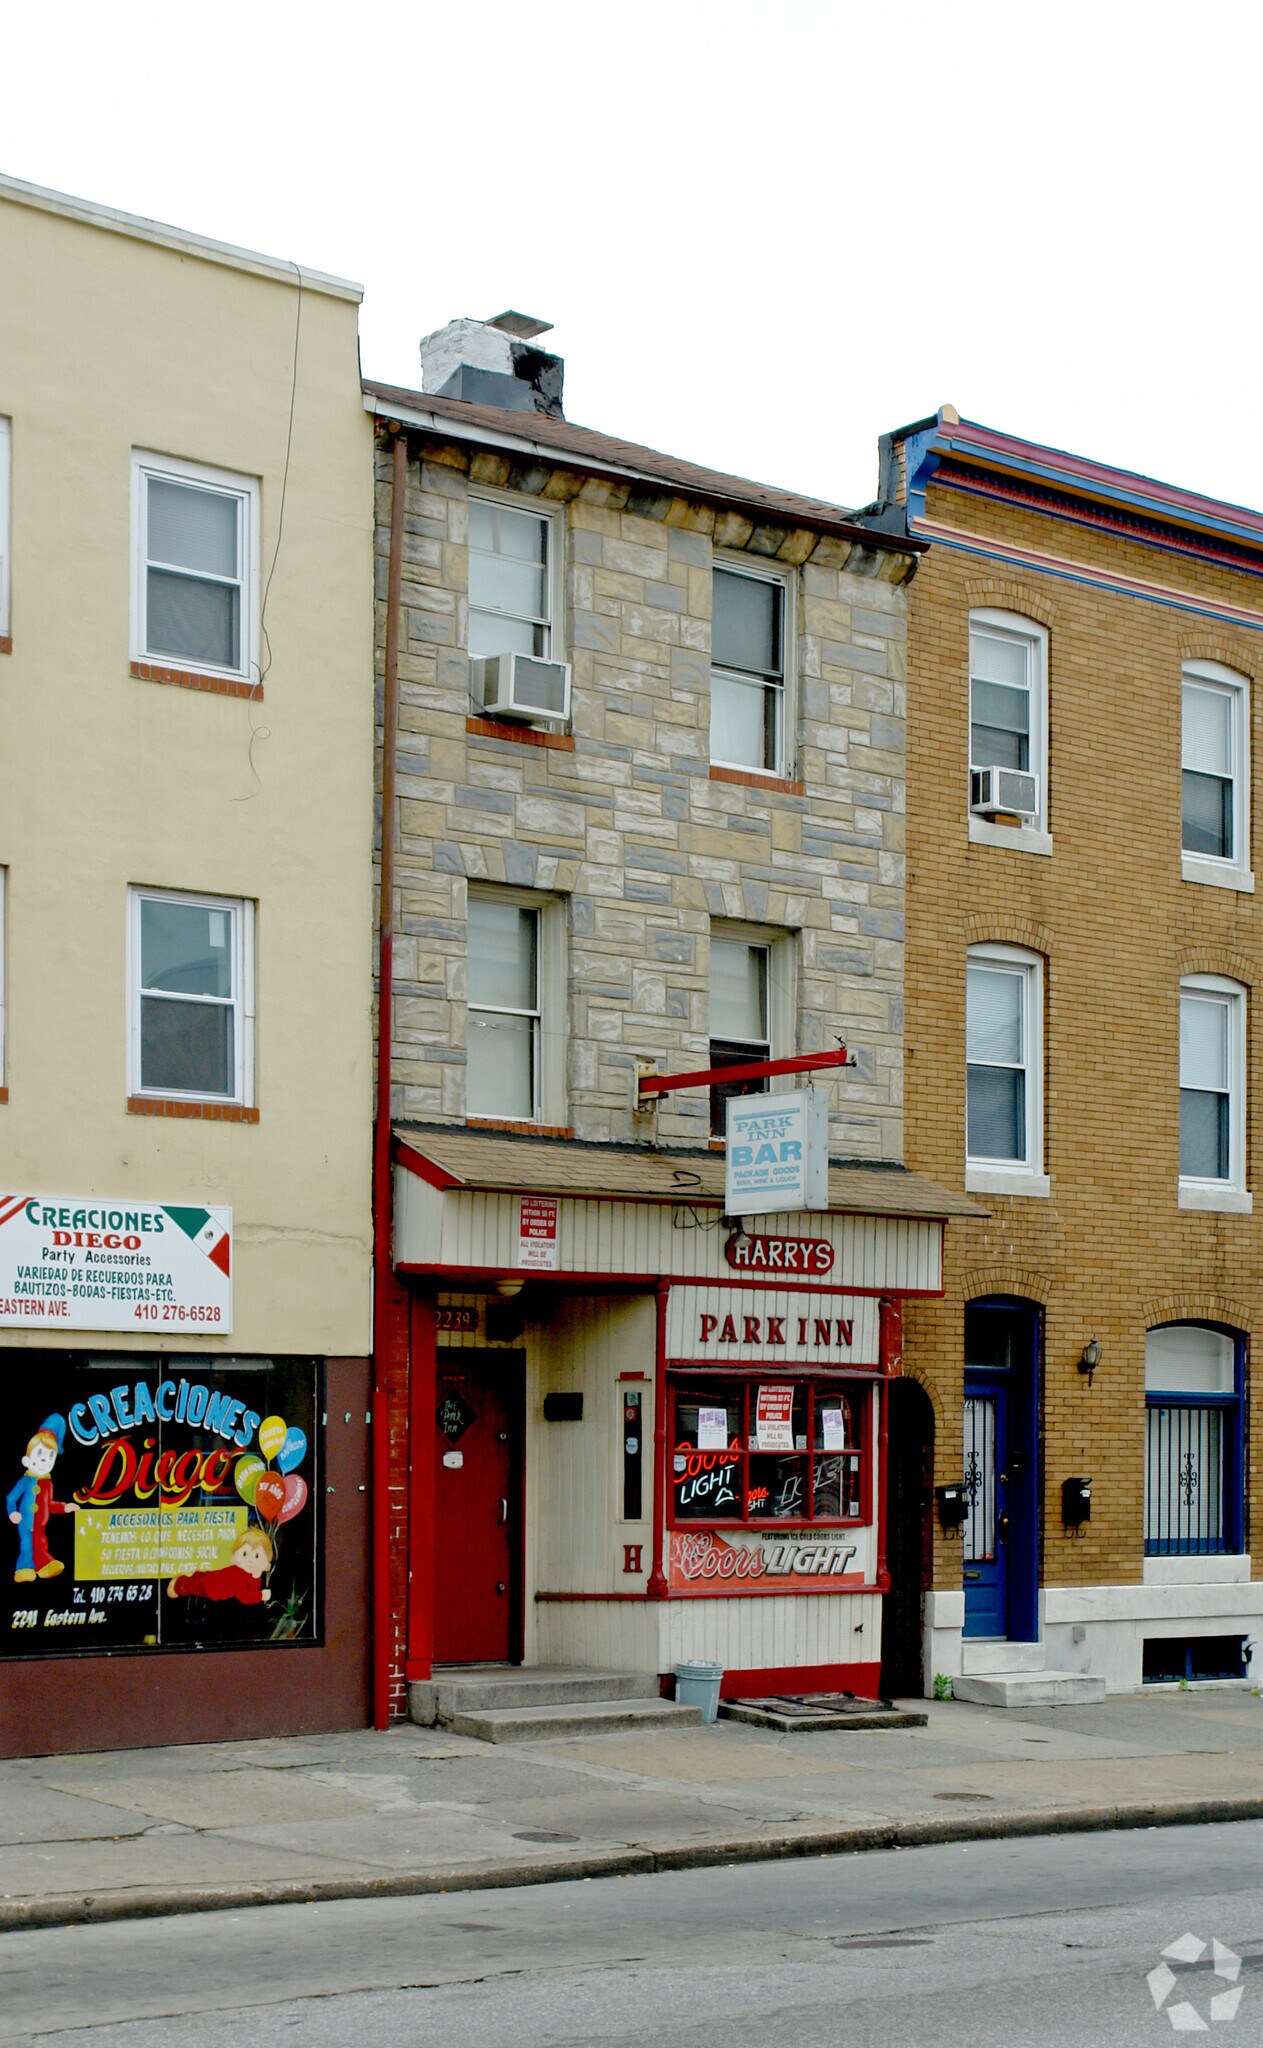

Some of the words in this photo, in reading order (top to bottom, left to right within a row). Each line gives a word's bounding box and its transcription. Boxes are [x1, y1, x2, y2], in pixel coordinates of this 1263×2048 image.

[736, 1116, 794, 1132] PARK
[747, 1128, 787, 1142] INN
[732, 1140, 802, 1167] BAR
[734, 1168, 769, 1178] PACKAGE
[773, 1166, 800, 1175] GOODS
[530, 1200, 557, 1208] LOITERING
[25, 1201, 164, 1233] CREACIONES
[530, 1219, 547, 1227] ORDER
[52, 1230, 142, 1250] DIEGO
[528, 1228, 547, 1236] POLICE
[42, 1247, 75, 1264] Party
[85, 1250, 151, 1266] Accessories
[734, 1239, 832, 1269] HARRYS
[17, 1266, 68, 1281] VARIEDAD
[71, 1268, 83, 1282] DE
[86, 1269, 143, 1285] RECUERDOS
[146, 1273, 173, 1286] PARA
[48, 1300, 70, 1317] AVE.
[134, 1304, 158, 1320] 410
[162, 1305, 221, 1322] 276-6528
[699, 1313, 786, 1345] PARK
[797, 1318, 855, 1346] INN
[68, 1378, 262, 1447] CREACIONES
[73, 1434, 248, 1509] Diego
[680, 1464, 735, 1504] LIGHT
[109, 1512, 173, 1528] ACCESORIOS
[176, 1512, 199, 1526] PARA
[203, 1511, 235, 1525] FIESTA
[101, 1530, 137, 1544] TENEMOS
[177, 1528, 214, 1542] NECESITA
[217, 1528, 237, 1541] PARA
[790, 1533, 799, 1541] ICE
[799, 1533, 812, 1541] COLD
[813, 1533, 830, 1541] COORS
[114, 1548, 140, 1561] FIESTA
[623, 1545, 643, 1573] H
[681, 1531, 767, 1580] Coors
[766, 1546, 856, 1576] LIGHT
[90, 1587, 106, 1603] 410
[107, 1586, 124, 1604] 276
[44, 1609, 87, 1627] Eastern
